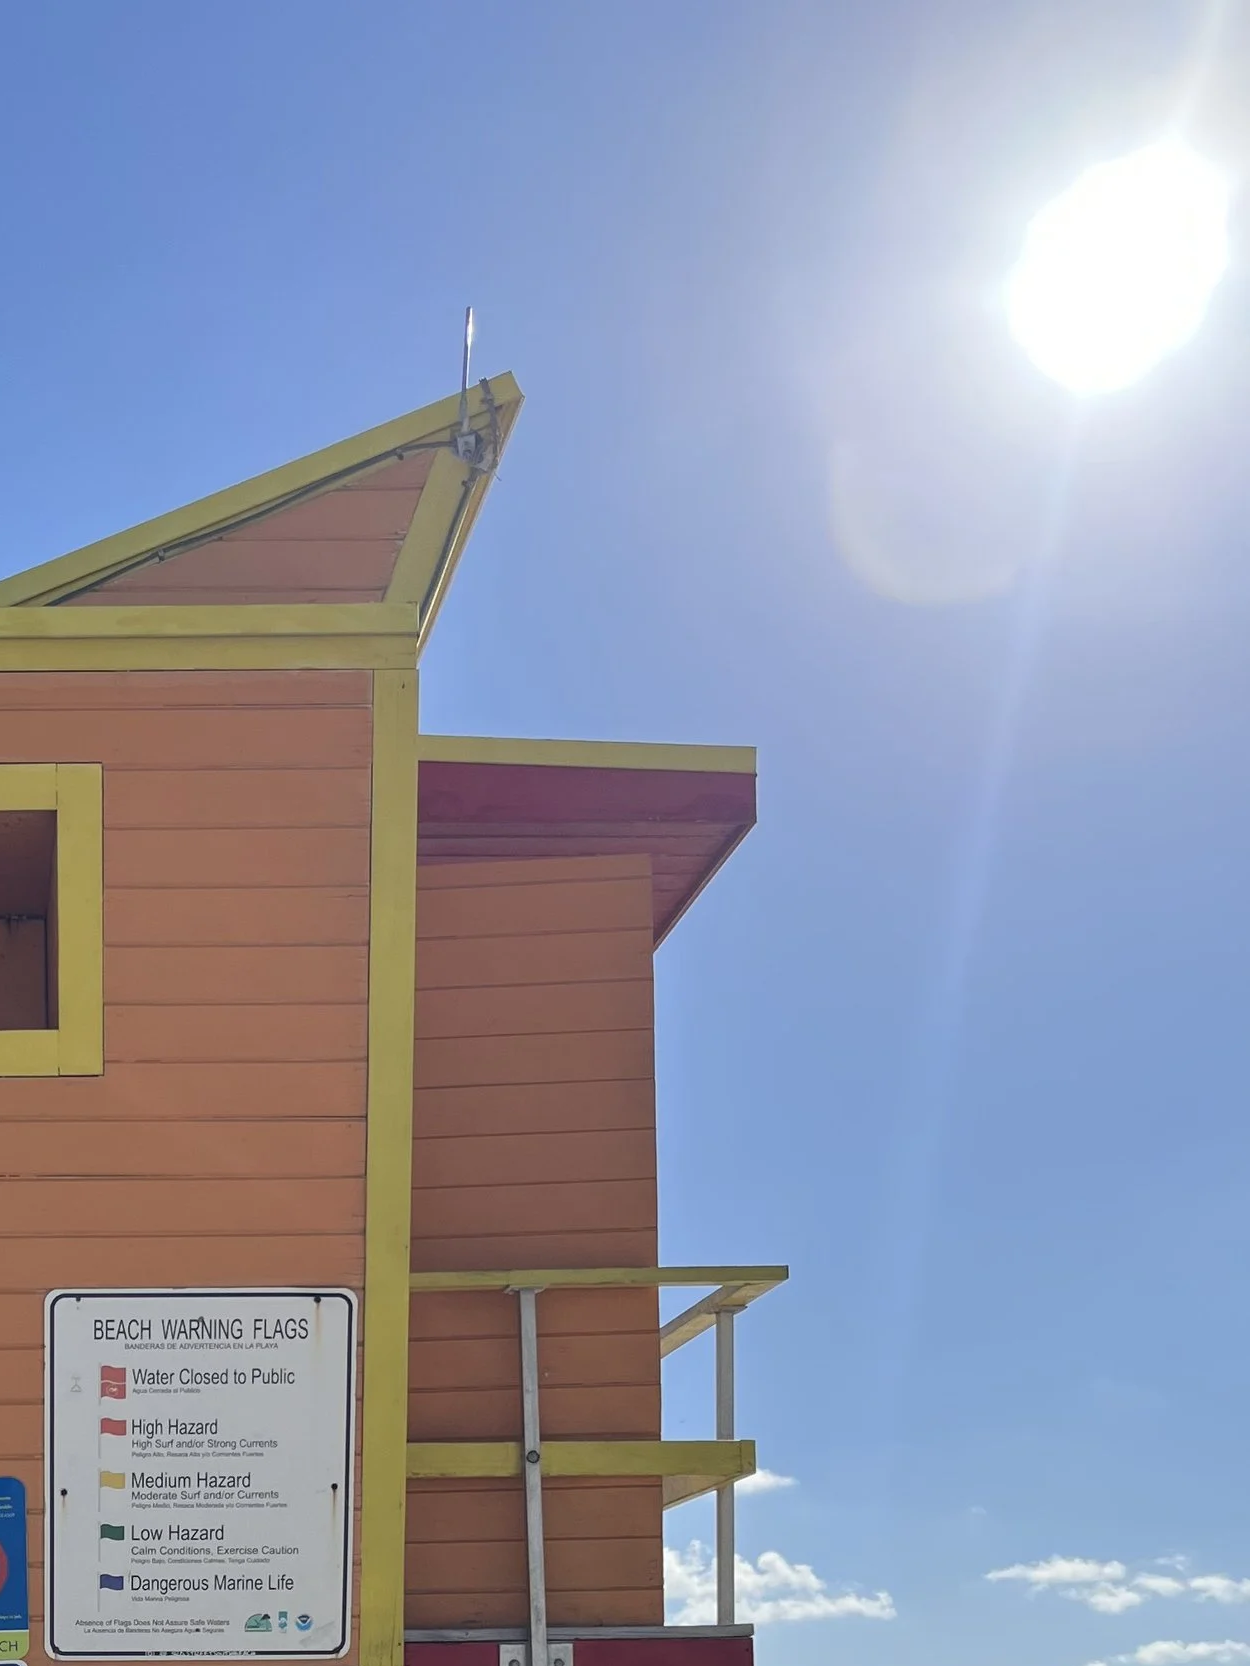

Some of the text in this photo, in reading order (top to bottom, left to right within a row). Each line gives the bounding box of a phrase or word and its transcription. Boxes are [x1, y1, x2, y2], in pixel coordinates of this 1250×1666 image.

[94, 1319, 308, 1340] BEACH WARNING FLAGS
[132, 1368, 295, 1385] Water Closed to Public
[132, 1419, 218, 1439] High Hazard
[132, 1438, 278, 1450] High Surf and/or Strong Currents
[132, 1472, 251, 1488] Medium Hazard
[131, 1490, 279, 1500] Moderate Surf and/or Currents
[131, 1525, 224, 1541] Low Hazard
[131, 1546, 299, 1556] Calm Conditions, Exercise Caution
[131, 1574, 294, 1595] Dangerous Marine Life
[113, 1619, 132, 1628] Flags
